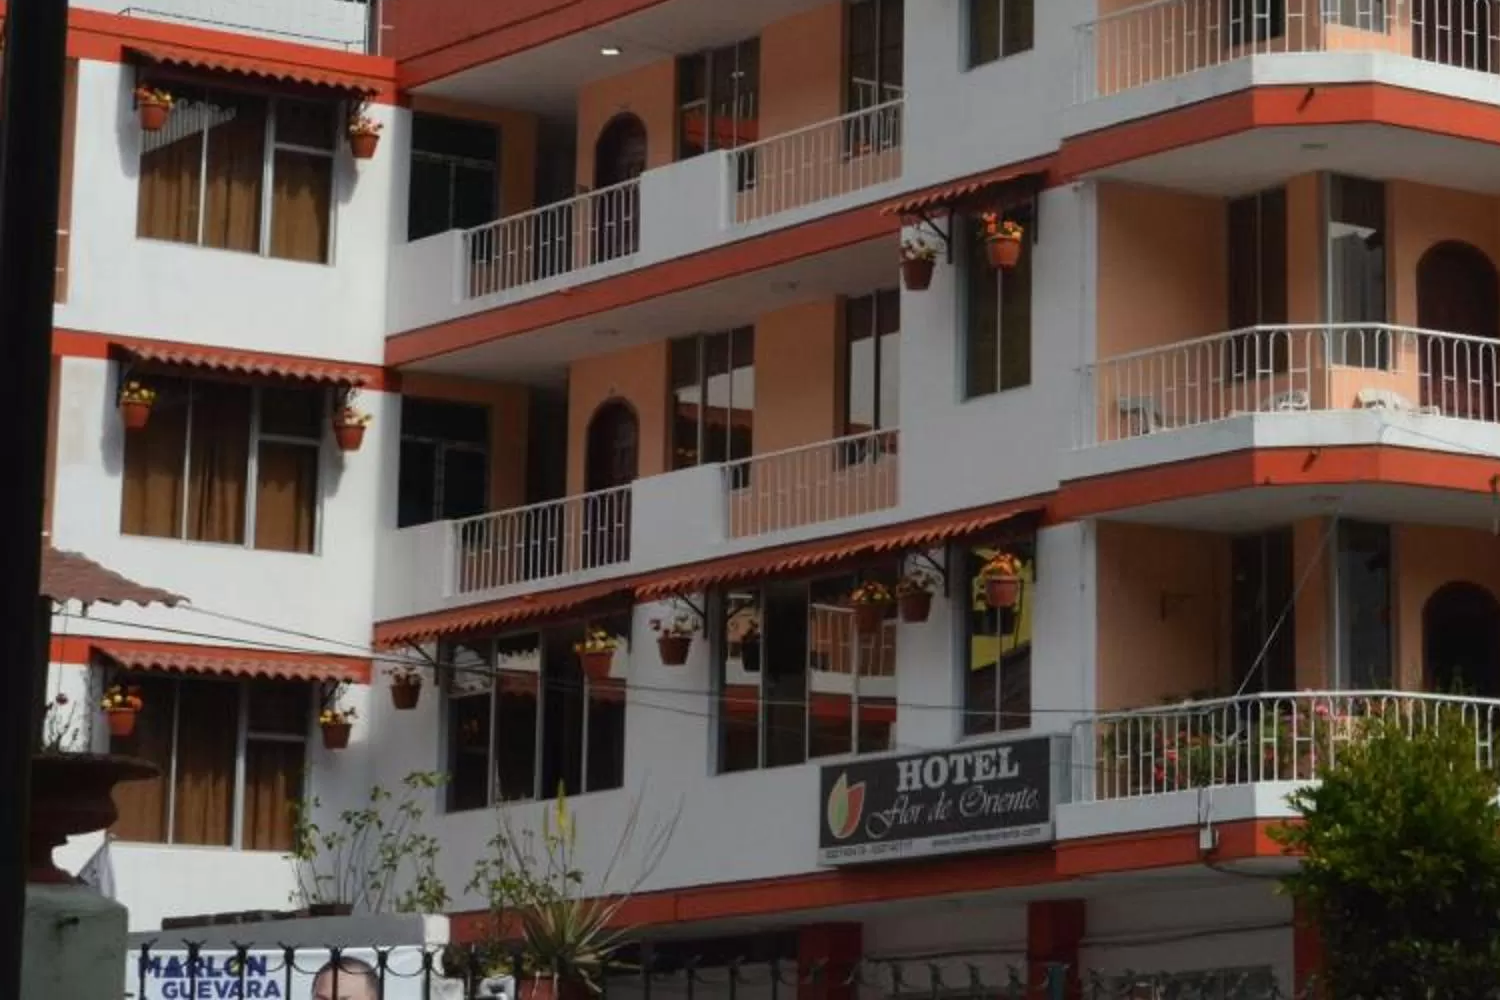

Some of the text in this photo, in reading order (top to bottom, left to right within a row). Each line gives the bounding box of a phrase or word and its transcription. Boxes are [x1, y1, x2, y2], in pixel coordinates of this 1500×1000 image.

[896, 747, 1019, 792] HOTEL
[865, 793, 925, 839] Flor
[927, 790, 951, 821] de
[959, 785, 1041, 817] Oriente
[138, 955, 268, 979] MARLON
[161, 978, 282, 999] GUEVARA
